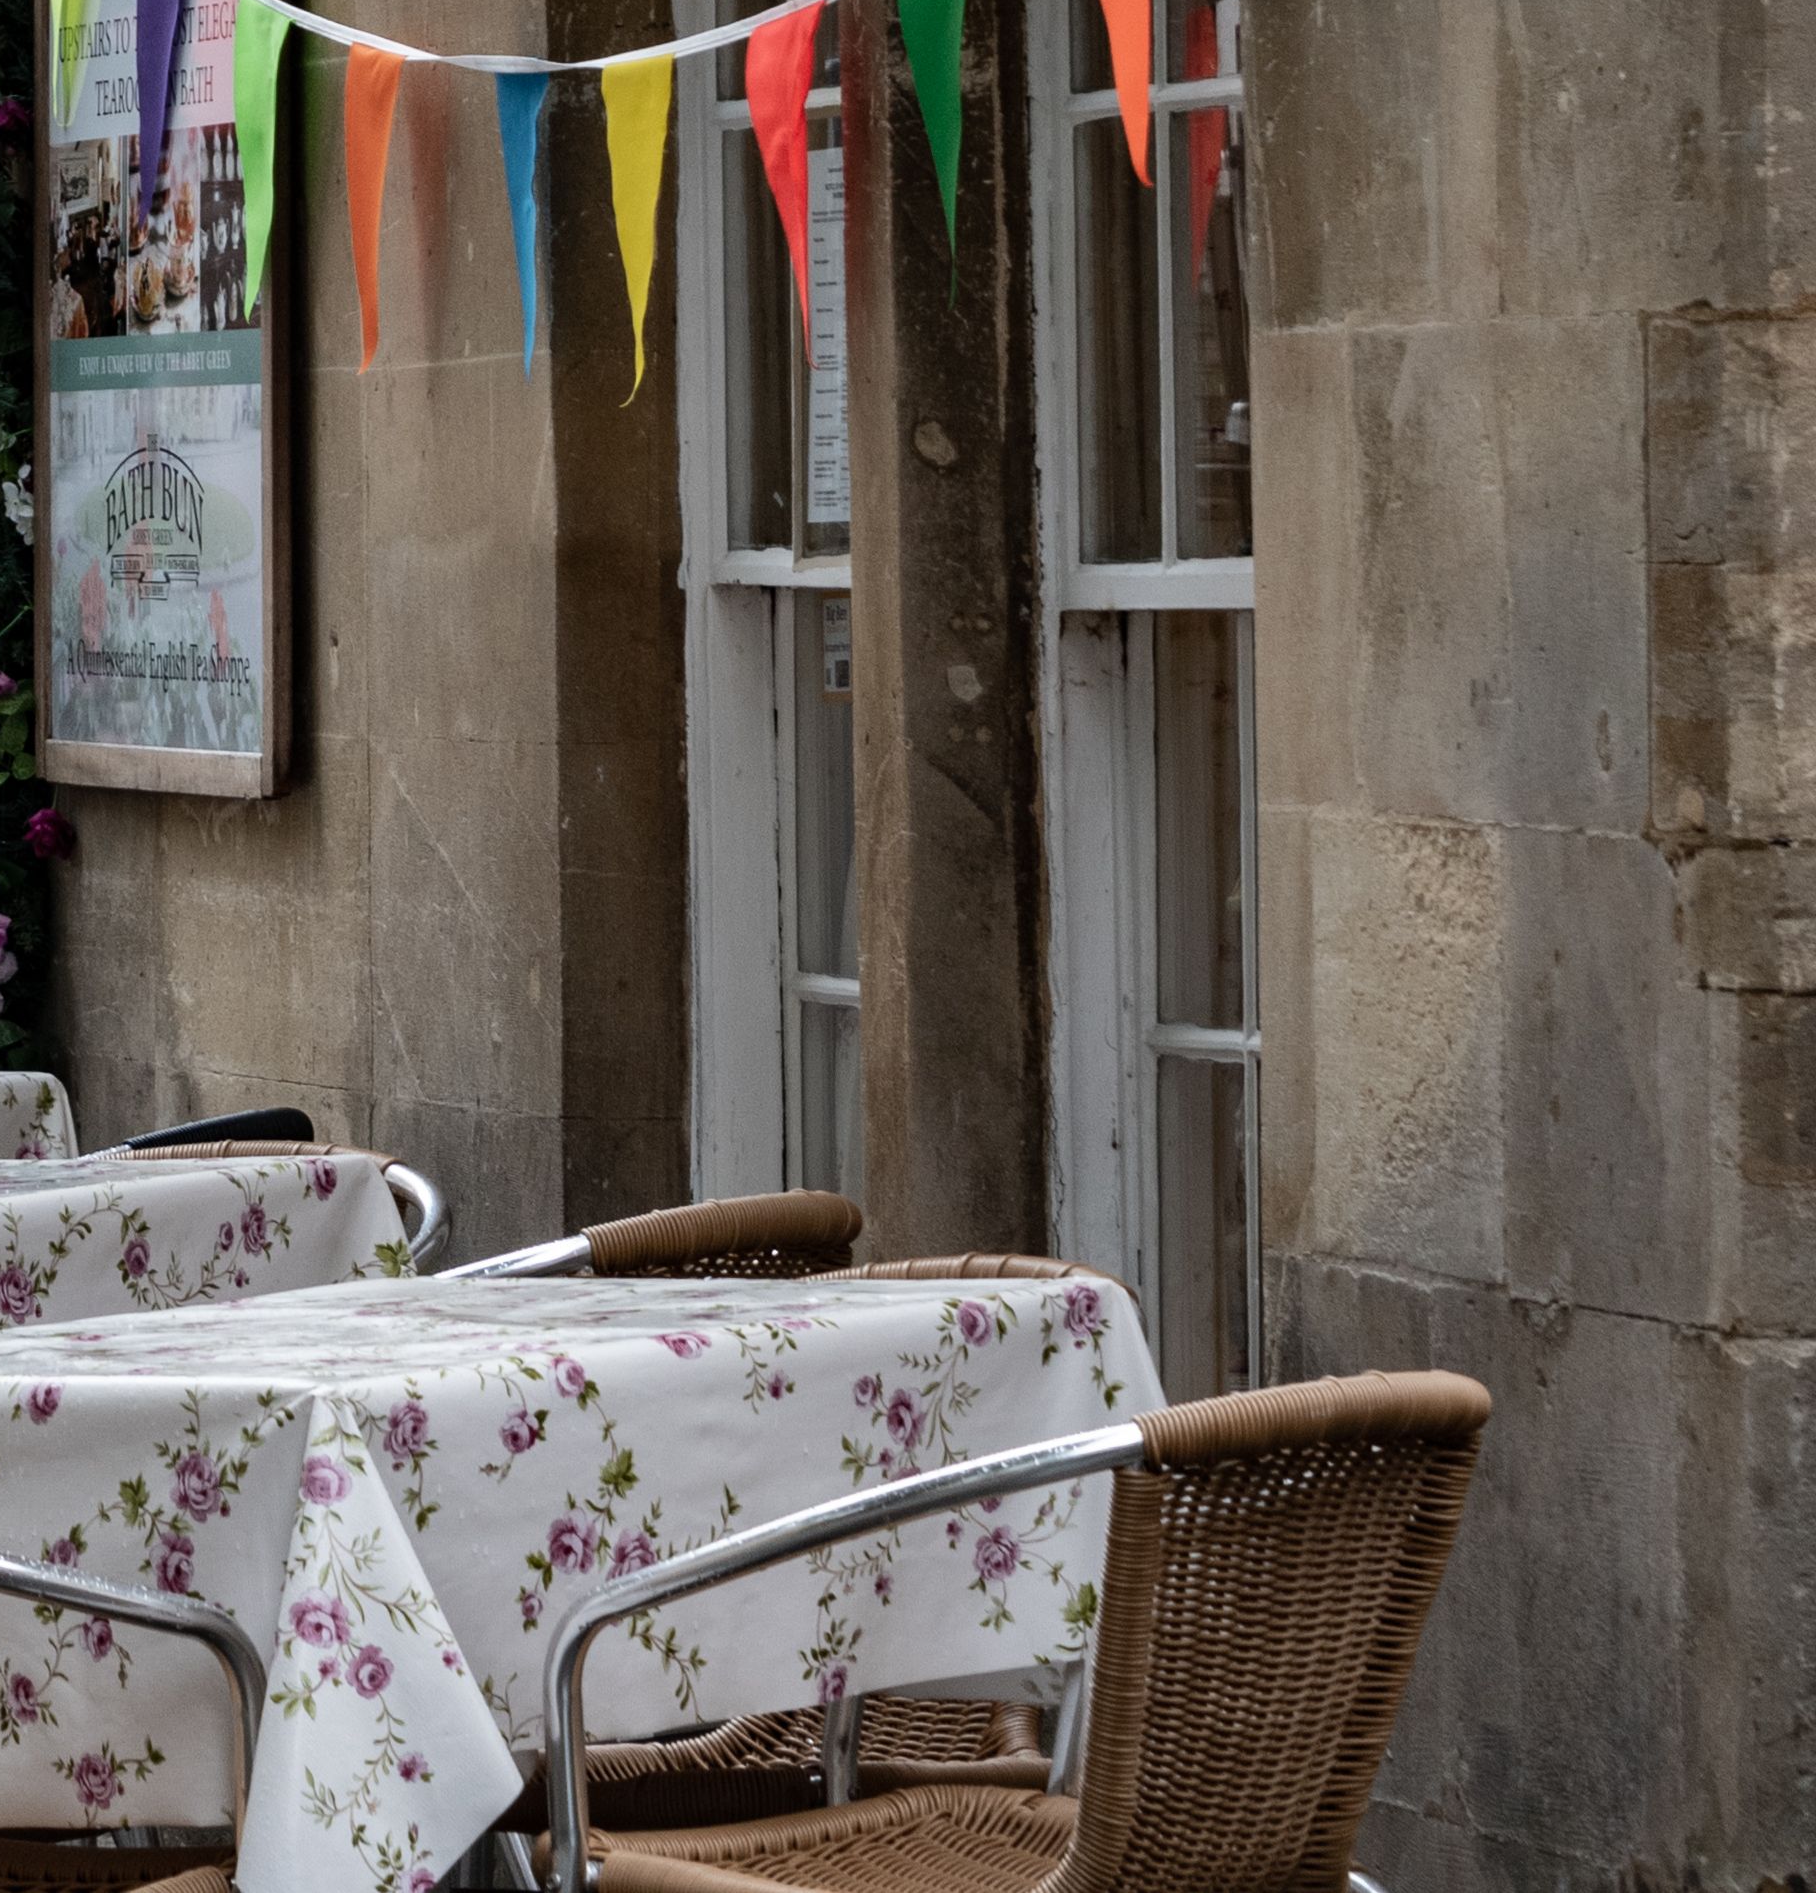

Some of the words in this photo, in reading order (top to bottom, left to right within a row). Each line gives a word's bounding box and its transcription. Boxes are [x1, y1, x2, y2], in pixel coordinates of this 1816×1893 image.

[58, 19, 111, 63] UPSTAIRS
[114, 17, 131, 55] TO
[197, 1, 236, 43] ELEGA
[95, 76, 141, 117] TEARO
[180, 65, 214, 106] BATH
[106, 461, 155, 555] BATH
[161, 462, 205, 555] BUN
[66, 639, 76, 676] A
[148, 640, 188, 694] English
[189, 643, 209, 683] Tea
[210, 641, 251, 697] Shoppe
